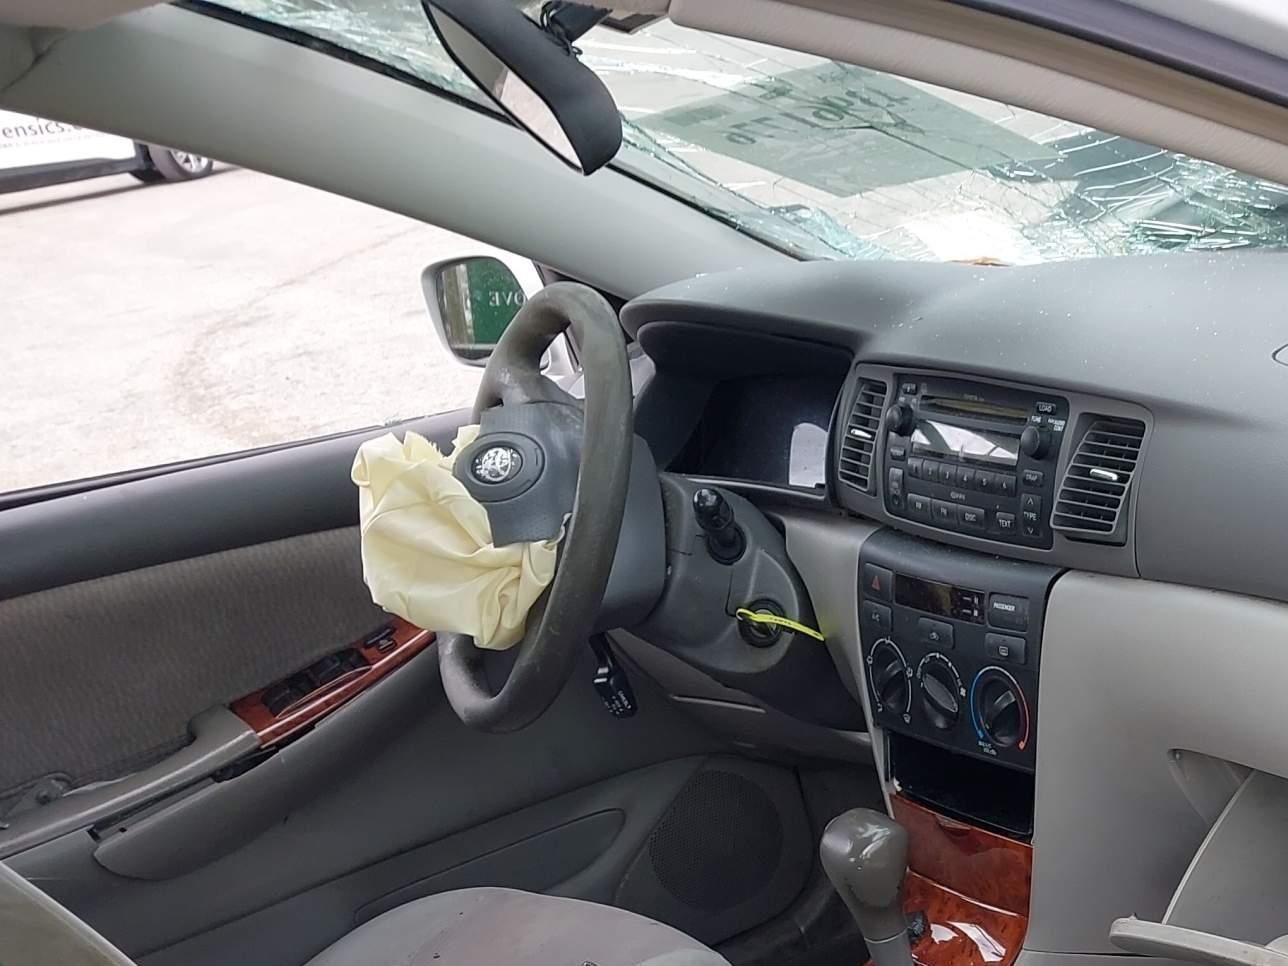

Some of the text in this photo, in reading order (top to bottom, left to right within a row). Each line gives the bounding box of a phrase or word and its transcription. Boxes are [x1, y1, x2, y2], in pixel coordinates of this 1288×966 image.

[2, 117, 82, 139] ensics.
[1023, 511, 1037, 521] TYPE
[998, 519, 1012, 528] TEXT
